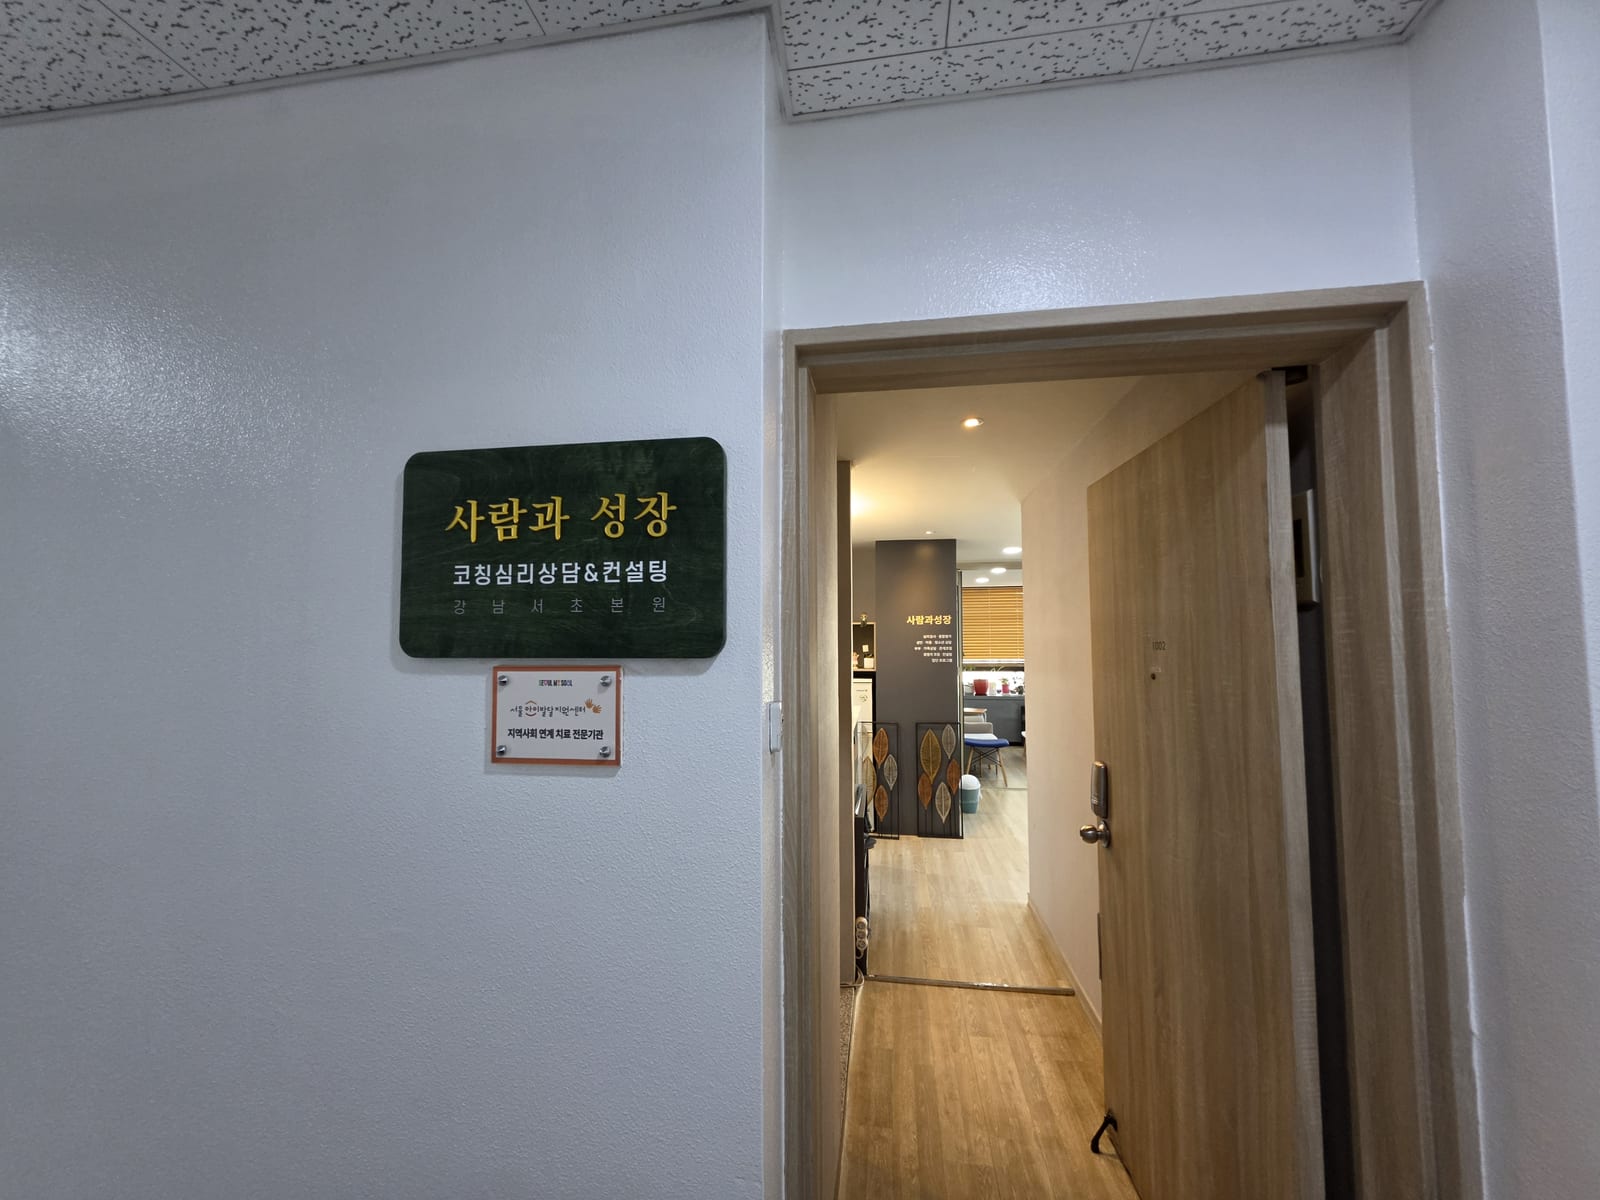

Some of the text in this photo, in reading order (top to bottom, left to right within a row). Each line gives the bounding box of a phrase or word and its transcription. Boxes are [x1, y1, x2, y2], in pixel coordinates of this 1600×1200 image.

[445, 491, 678, 544] 사람과 성장
[453, 560, 668, 586] 코칭심리상담&컨설팅
[906, 615, 952, 625] 사람과성장
[1152, 641, 1166, 650] 1002
[507, 728, 604, 740] 지역사회 연계 치료 전문기관
